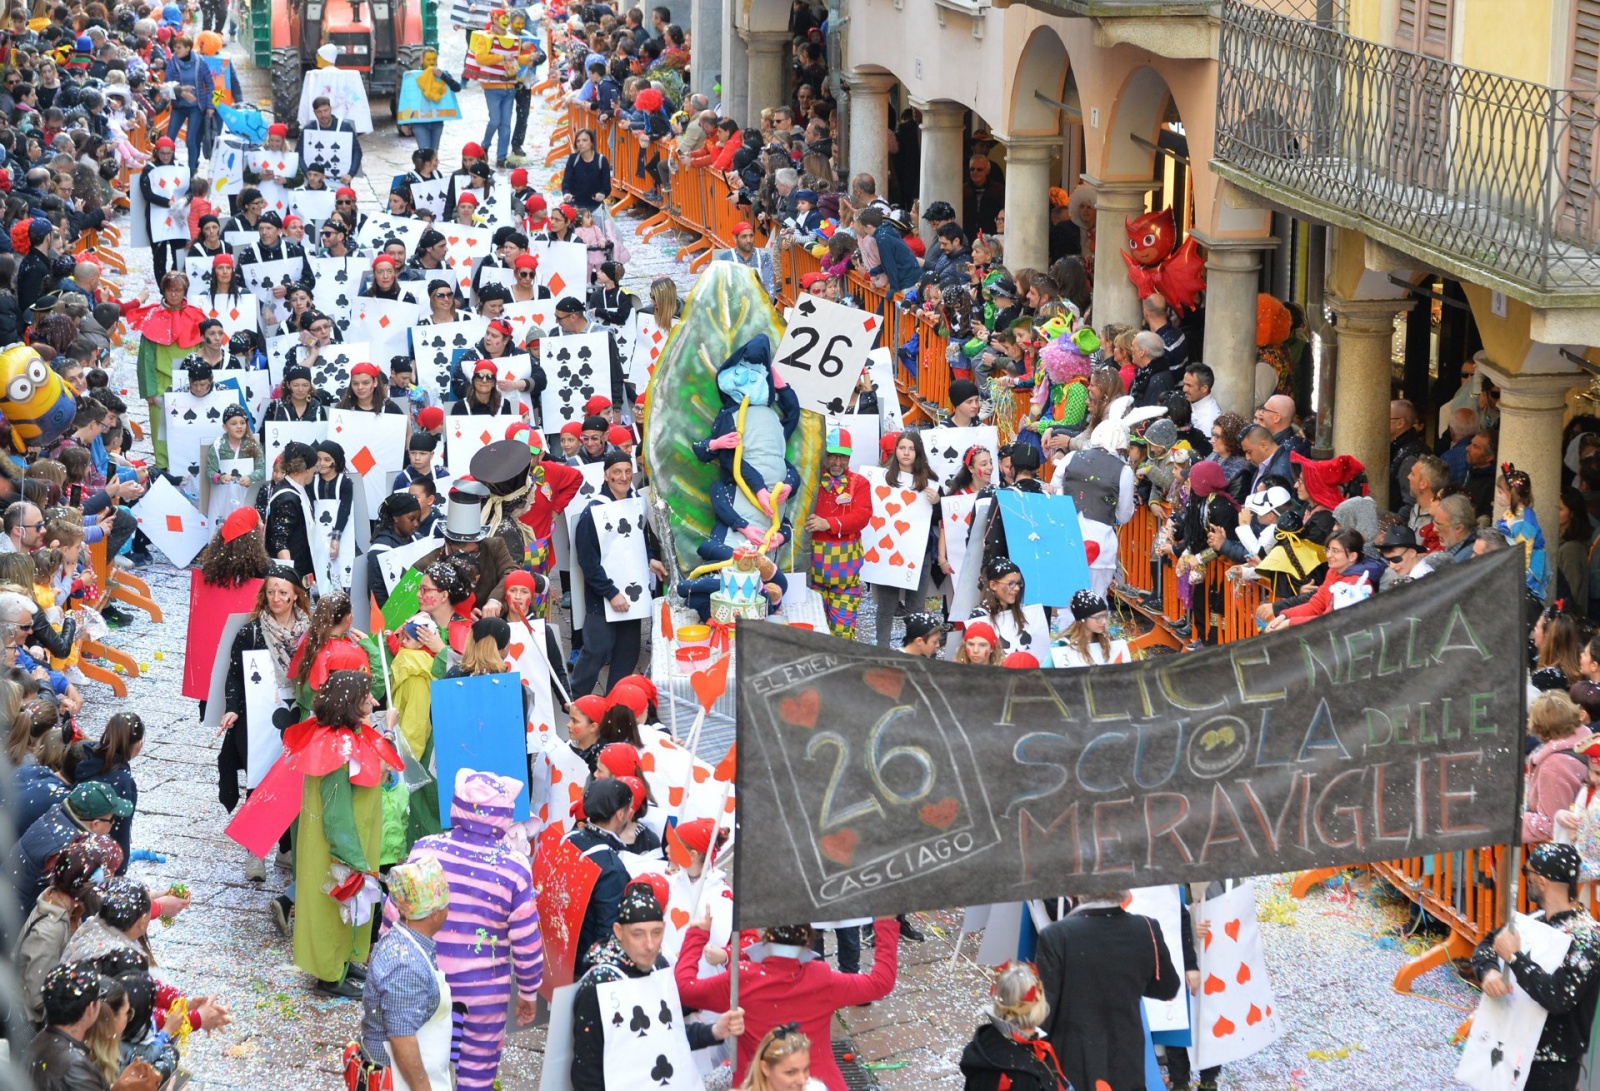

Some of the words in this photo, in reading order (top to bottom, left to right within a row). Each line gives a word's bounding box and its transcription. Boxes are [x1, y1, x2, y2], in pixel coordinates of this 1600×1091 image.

[250, 268, 256, 278] 6
[360, 302, 366, 312] 2
[421, 330, 426, 338] 9
[272, 341, 278, 350] 8
[546, 342, 552, 350] 9
[778, 327, 853, 378] 26
[172, 398, 176, 406] 4
[336, 414, 344, 425] A
[454, 420, 460, 430] 3
[272, 428, 278, 438] 9
[930, 435, 938, 446] 6
[948, 501, 960, 512] 10
[603, 511, 608, 520] 4
[386, 558, 392, 570] 5
[906, 571, 913, 582] 8
[250, 658, 258, 670] A
[993, 648, 1287, 726] ALICE
[1299, 603, 1494, 688] NELLA
[1062, 654, 1070, 666] 3
[1000, 697, 1352, 818] SCUOLA
[1362, 692, 1498, 747] DELLE
[803, 700, 937, 829] 26
[1014, 752, 1490, 884] MERAVIGLIE
[819, 831, 974, 900] CASCIAGO
[610, 991, 620, 1010] 5
